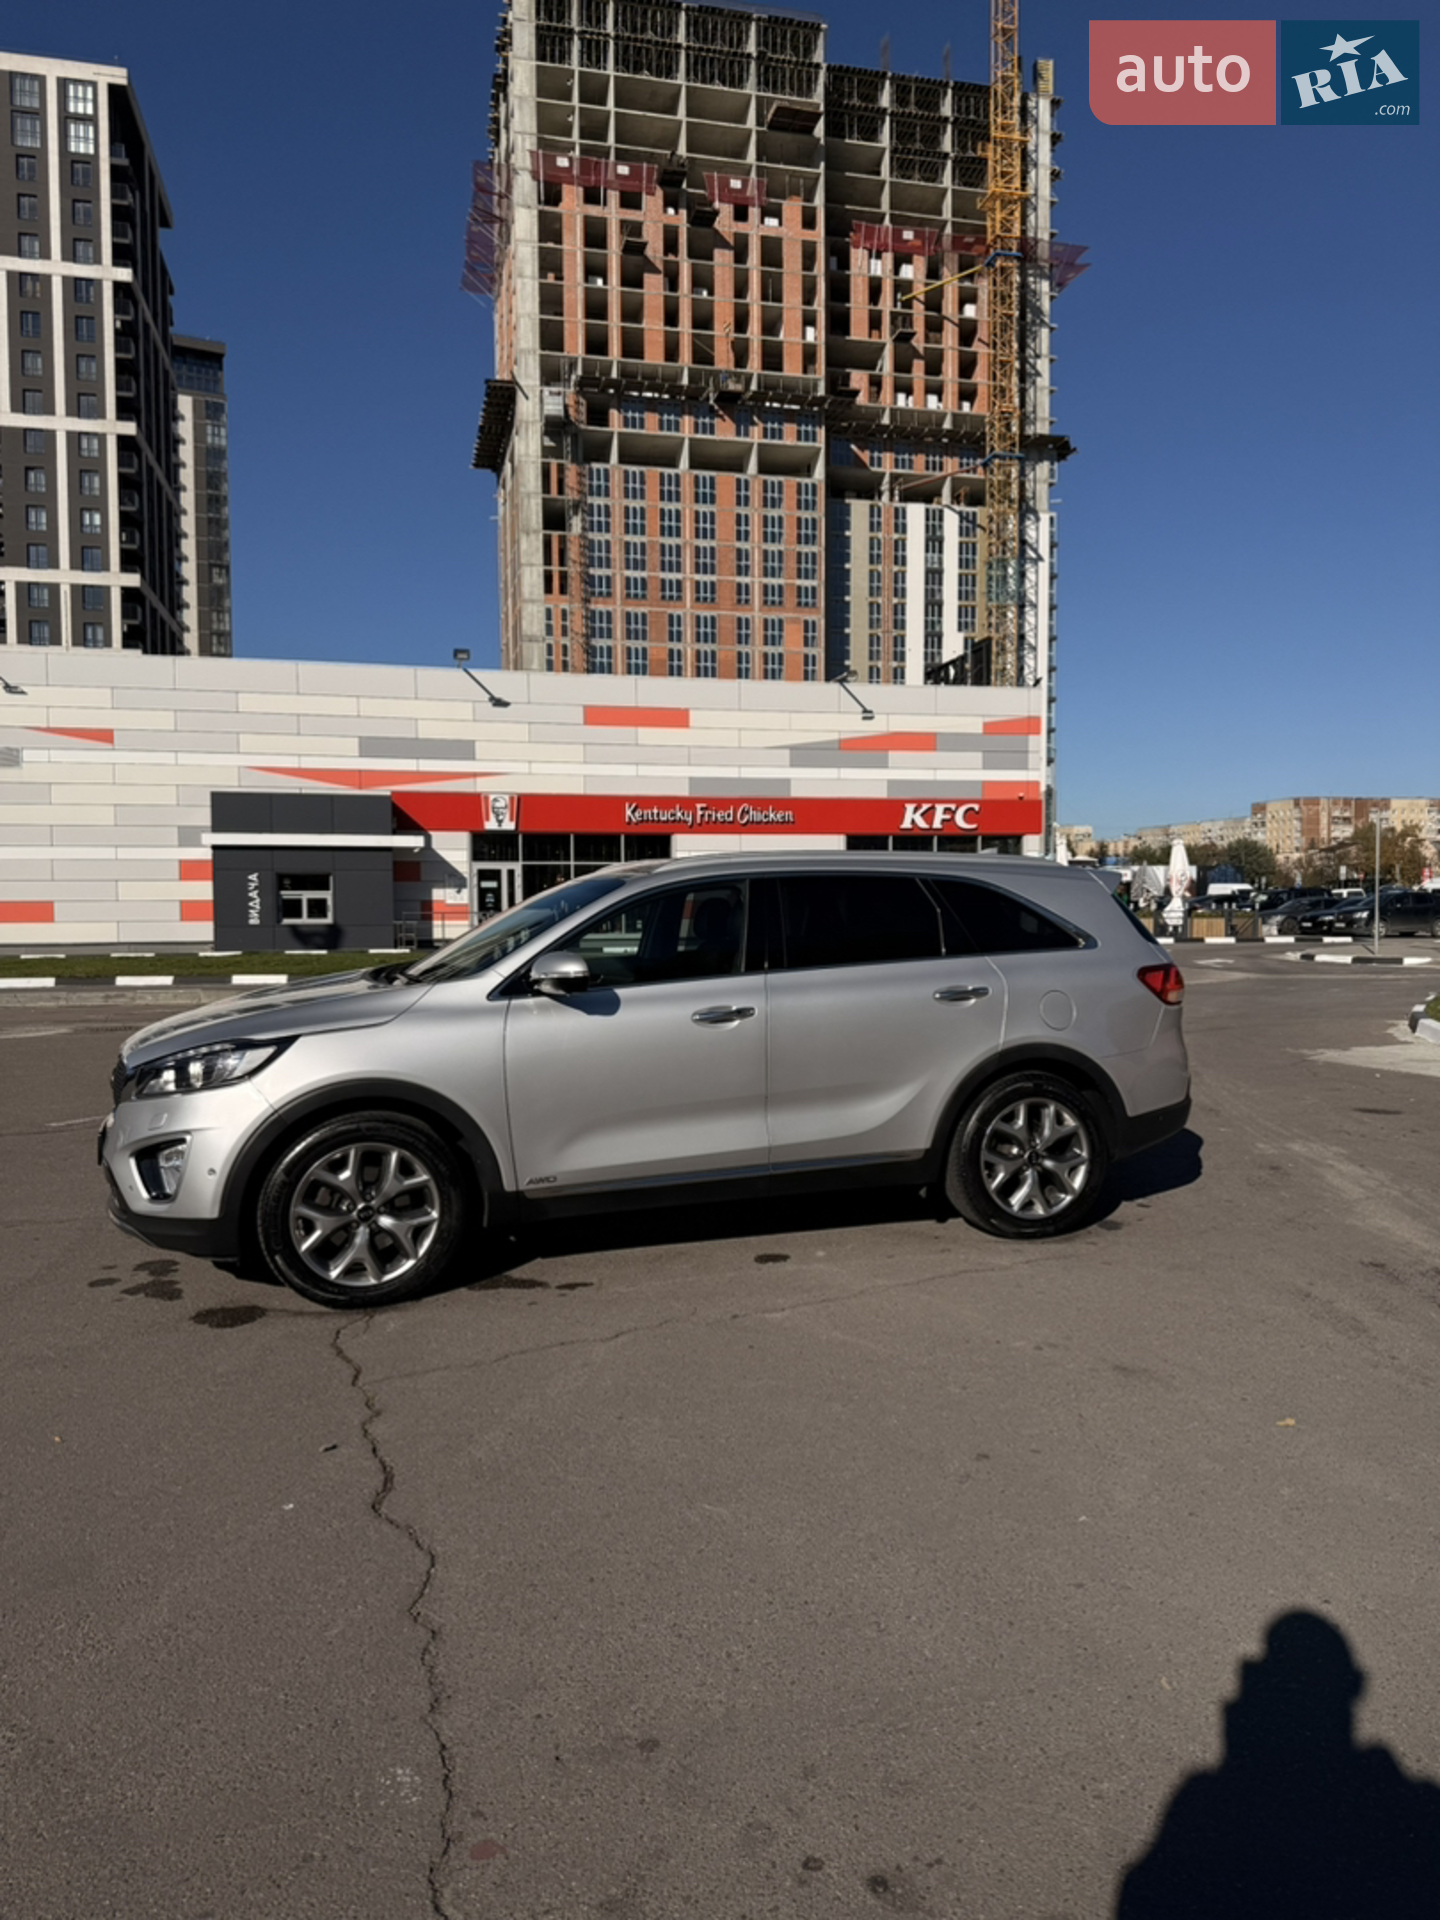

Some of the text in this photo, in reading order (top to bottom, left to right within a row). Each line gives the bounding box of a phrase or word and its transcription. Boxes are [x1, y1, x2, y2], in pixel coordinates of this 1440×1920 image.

[625, 802, 794, 826] Kentucky Fried Chicken
[899, 803, 980, 829] KFC
[247, 872, 261, 925] ВИДАЧА
